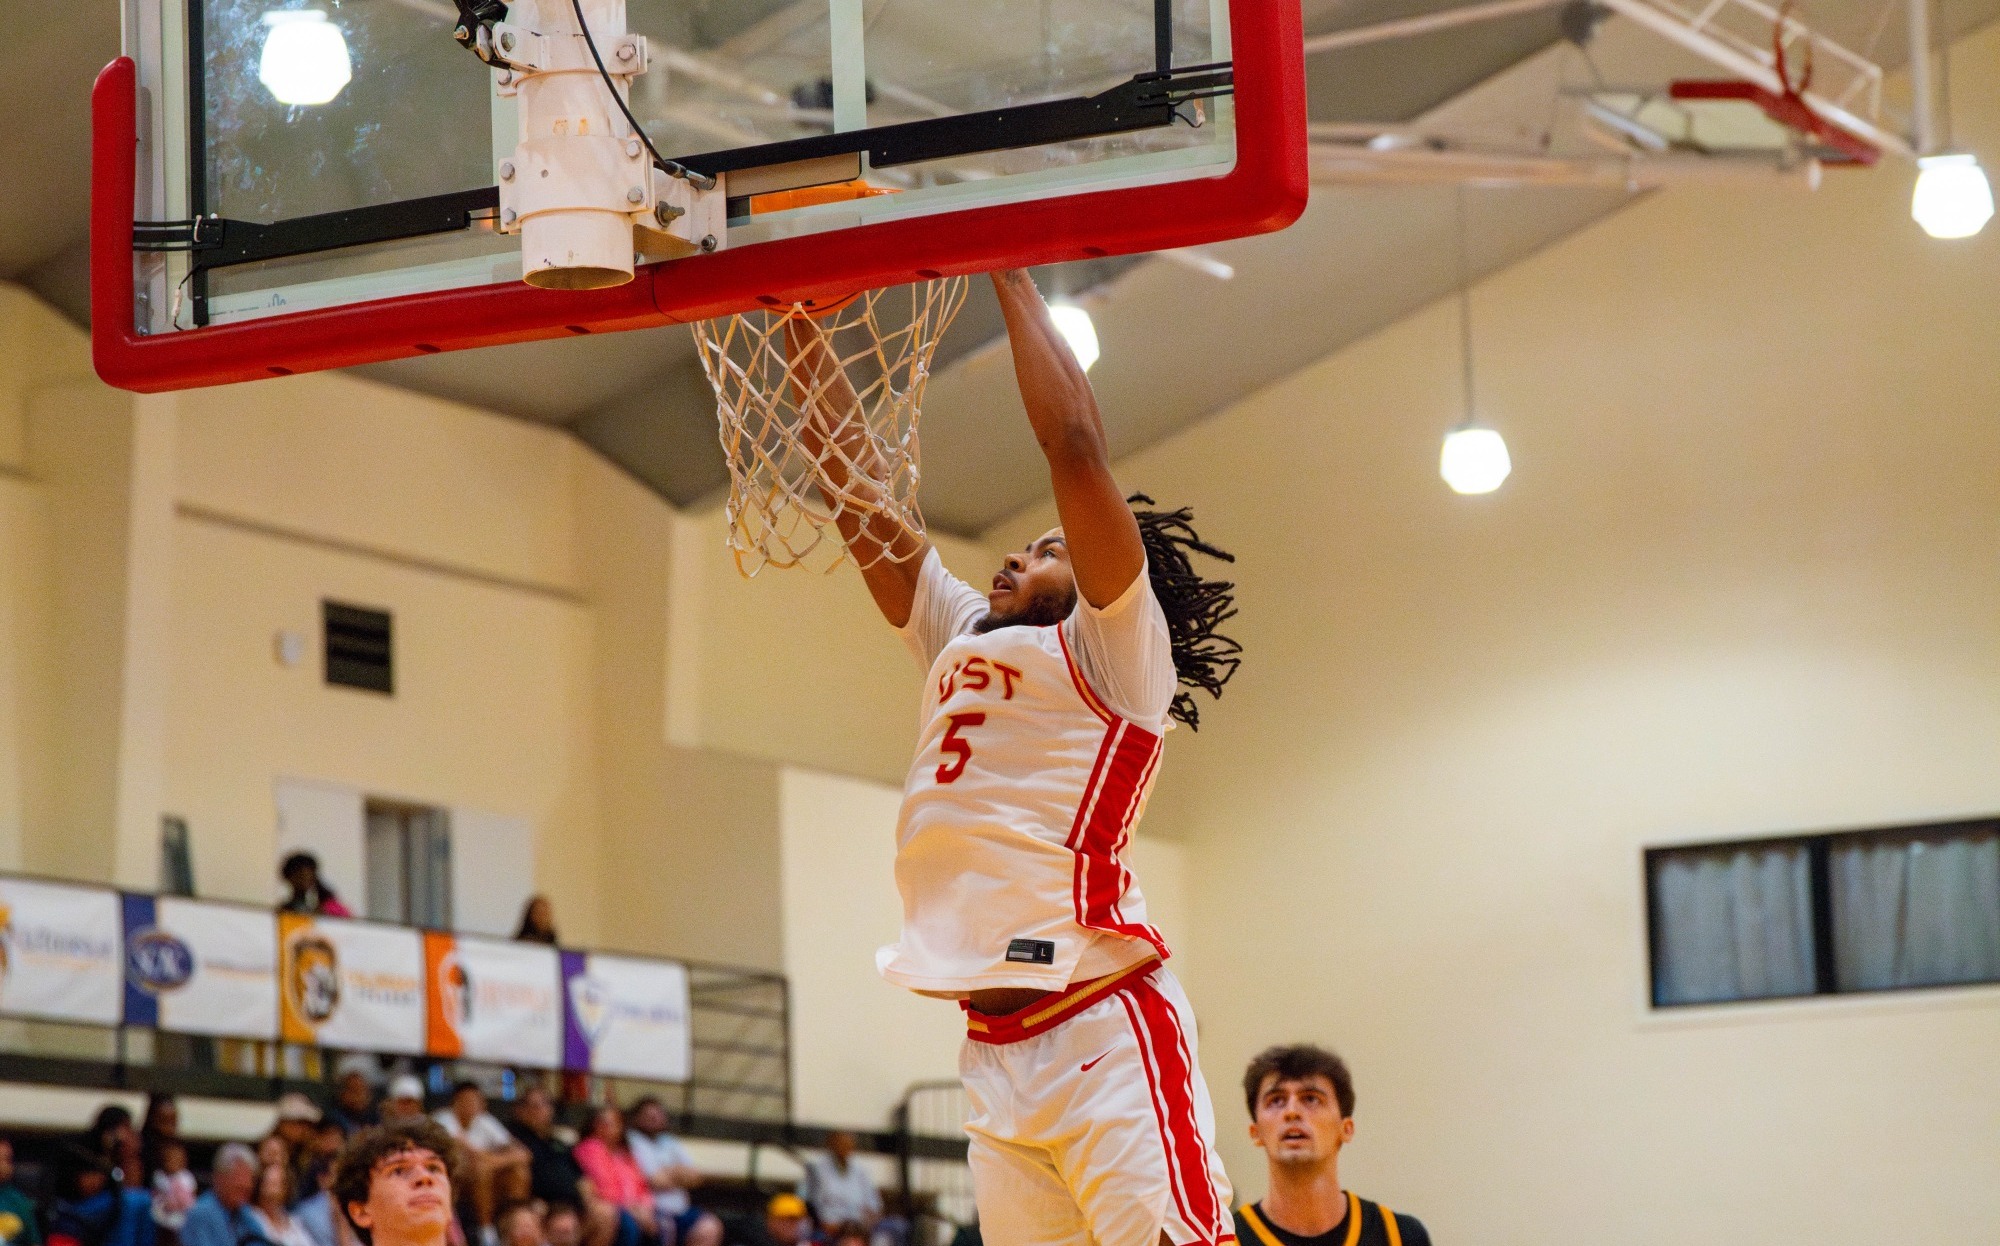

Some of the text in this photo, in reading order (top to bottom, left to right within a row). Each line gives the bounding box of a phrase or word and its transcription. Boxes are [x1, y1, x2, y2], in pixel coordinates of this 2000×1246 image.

[938, 656, 1023, 704] UST
[935, 711, 987, 785] 5
[1040, 947, 1046, 957] L
